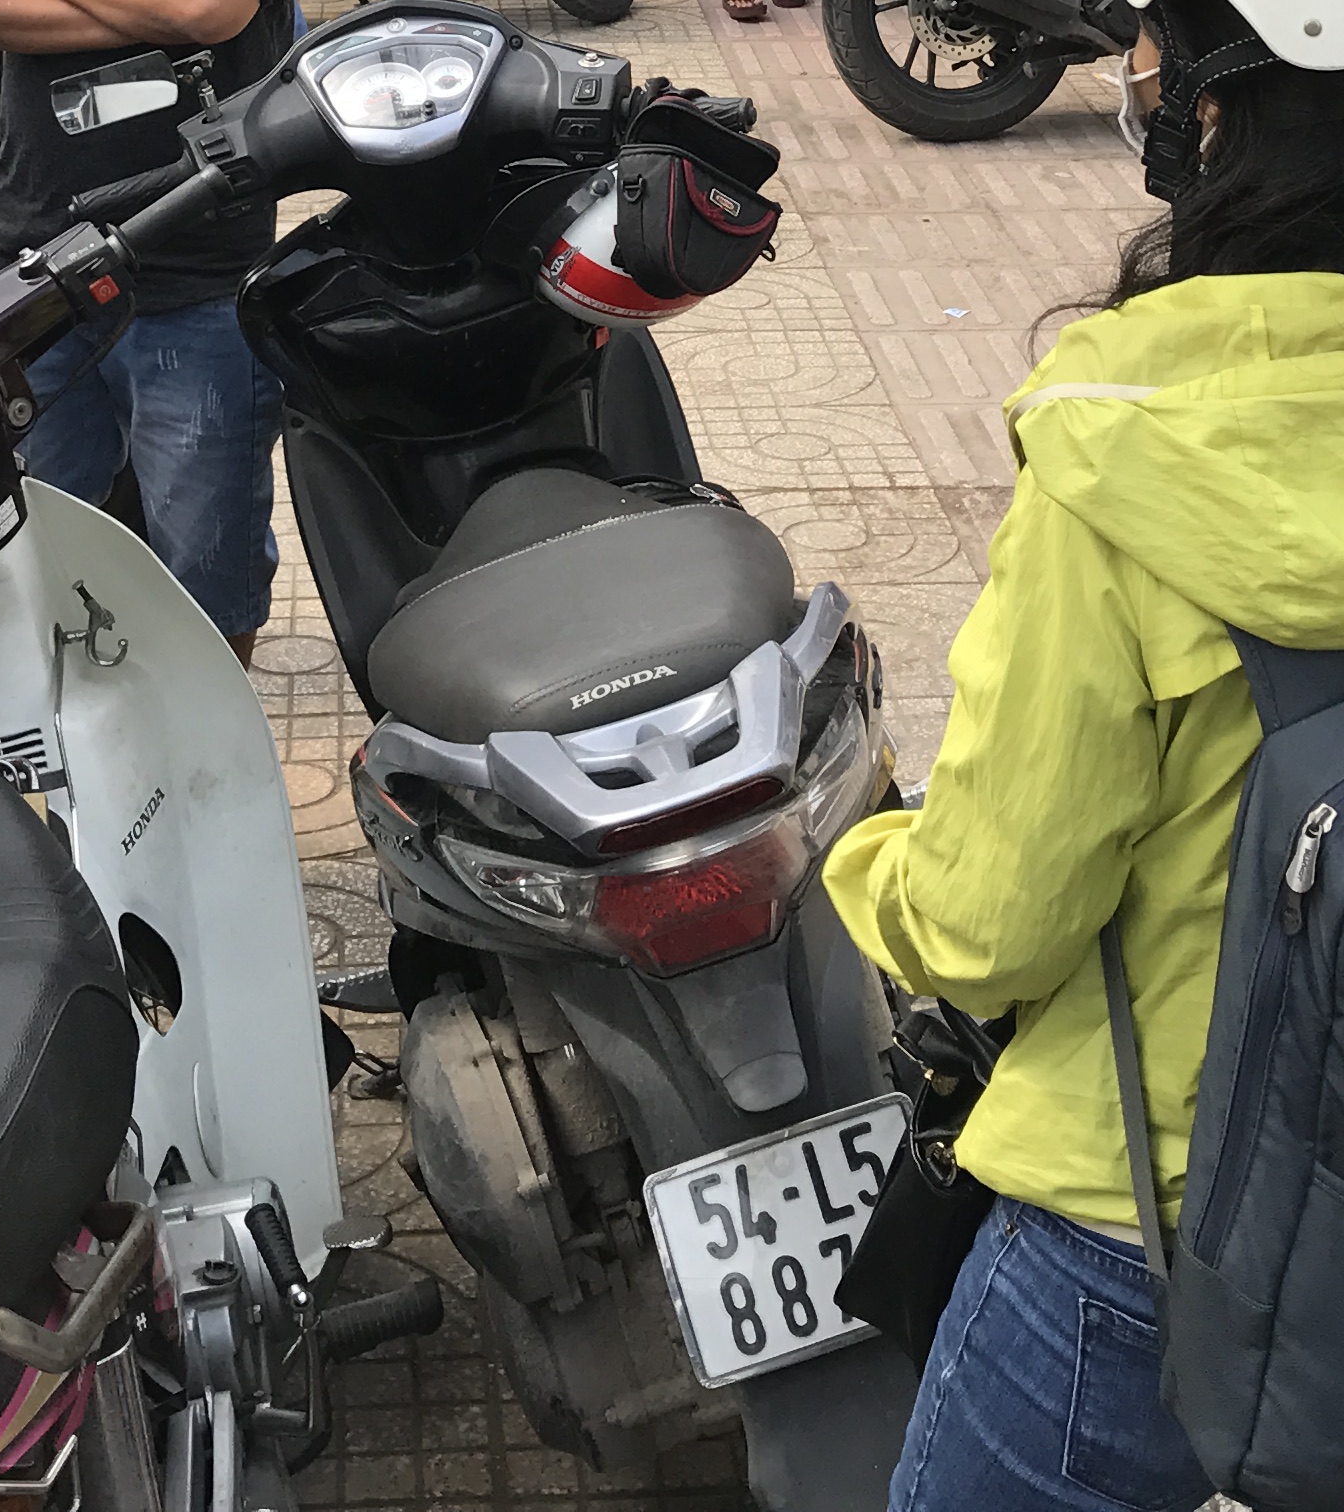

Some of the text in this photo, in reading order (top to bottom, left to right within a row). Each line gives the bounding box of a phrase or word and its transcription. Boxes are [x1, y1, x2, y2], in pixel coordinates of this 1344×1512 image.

[568, 663, 677, 711] HONDA
[120, 787, 166, 856] HONDA
[719, 1233, 854, 1356] 887
